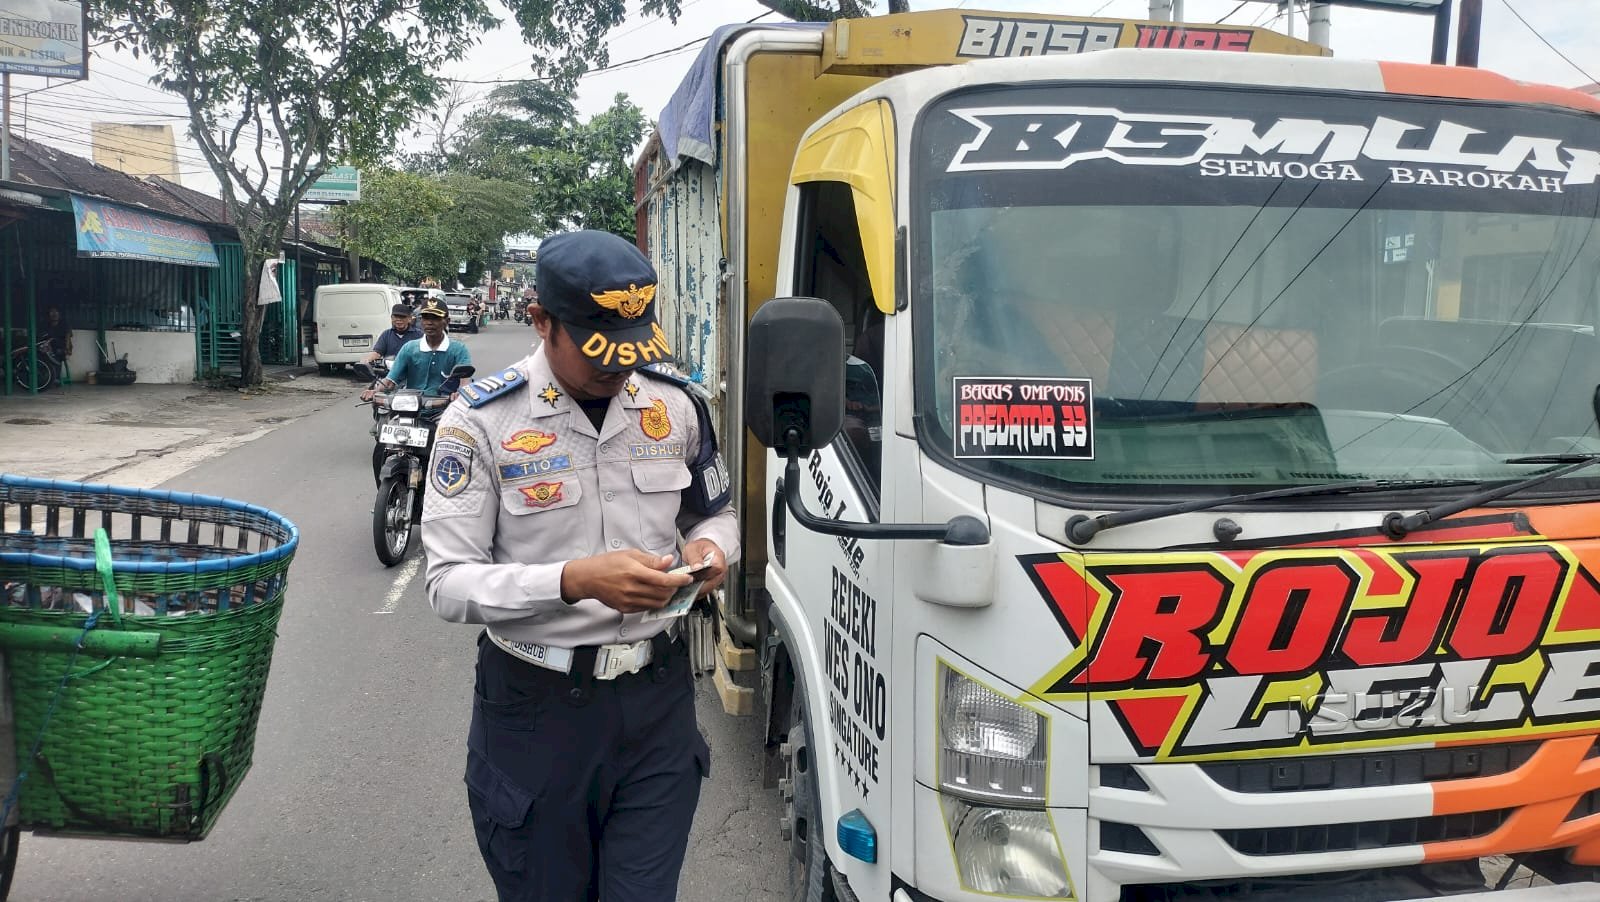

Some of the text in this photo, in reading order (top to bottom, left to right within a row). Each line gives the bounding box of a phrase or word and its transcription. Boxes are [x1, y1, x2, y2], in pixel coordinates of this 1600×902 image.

[1199, 158, 1565, 193] SEMOGA BAROKAH
[960, 384, 1086, 403] BAGUS OMPONK
[960, 404, 1057, 453] PREDATOR
[520, 459, 551, 475] TIO
[808, 449, 834, 510] Rojo
[831, 564, 877, 660] REJEKI
[1068, 549, 1565, 686] ROJO
[823, 615, 850, 701] WES
[853, 650, 886, 742] ONO
[829, 689, 880, 785] SINGATURE
[1287, 685, 1481, 736] ISUZU
